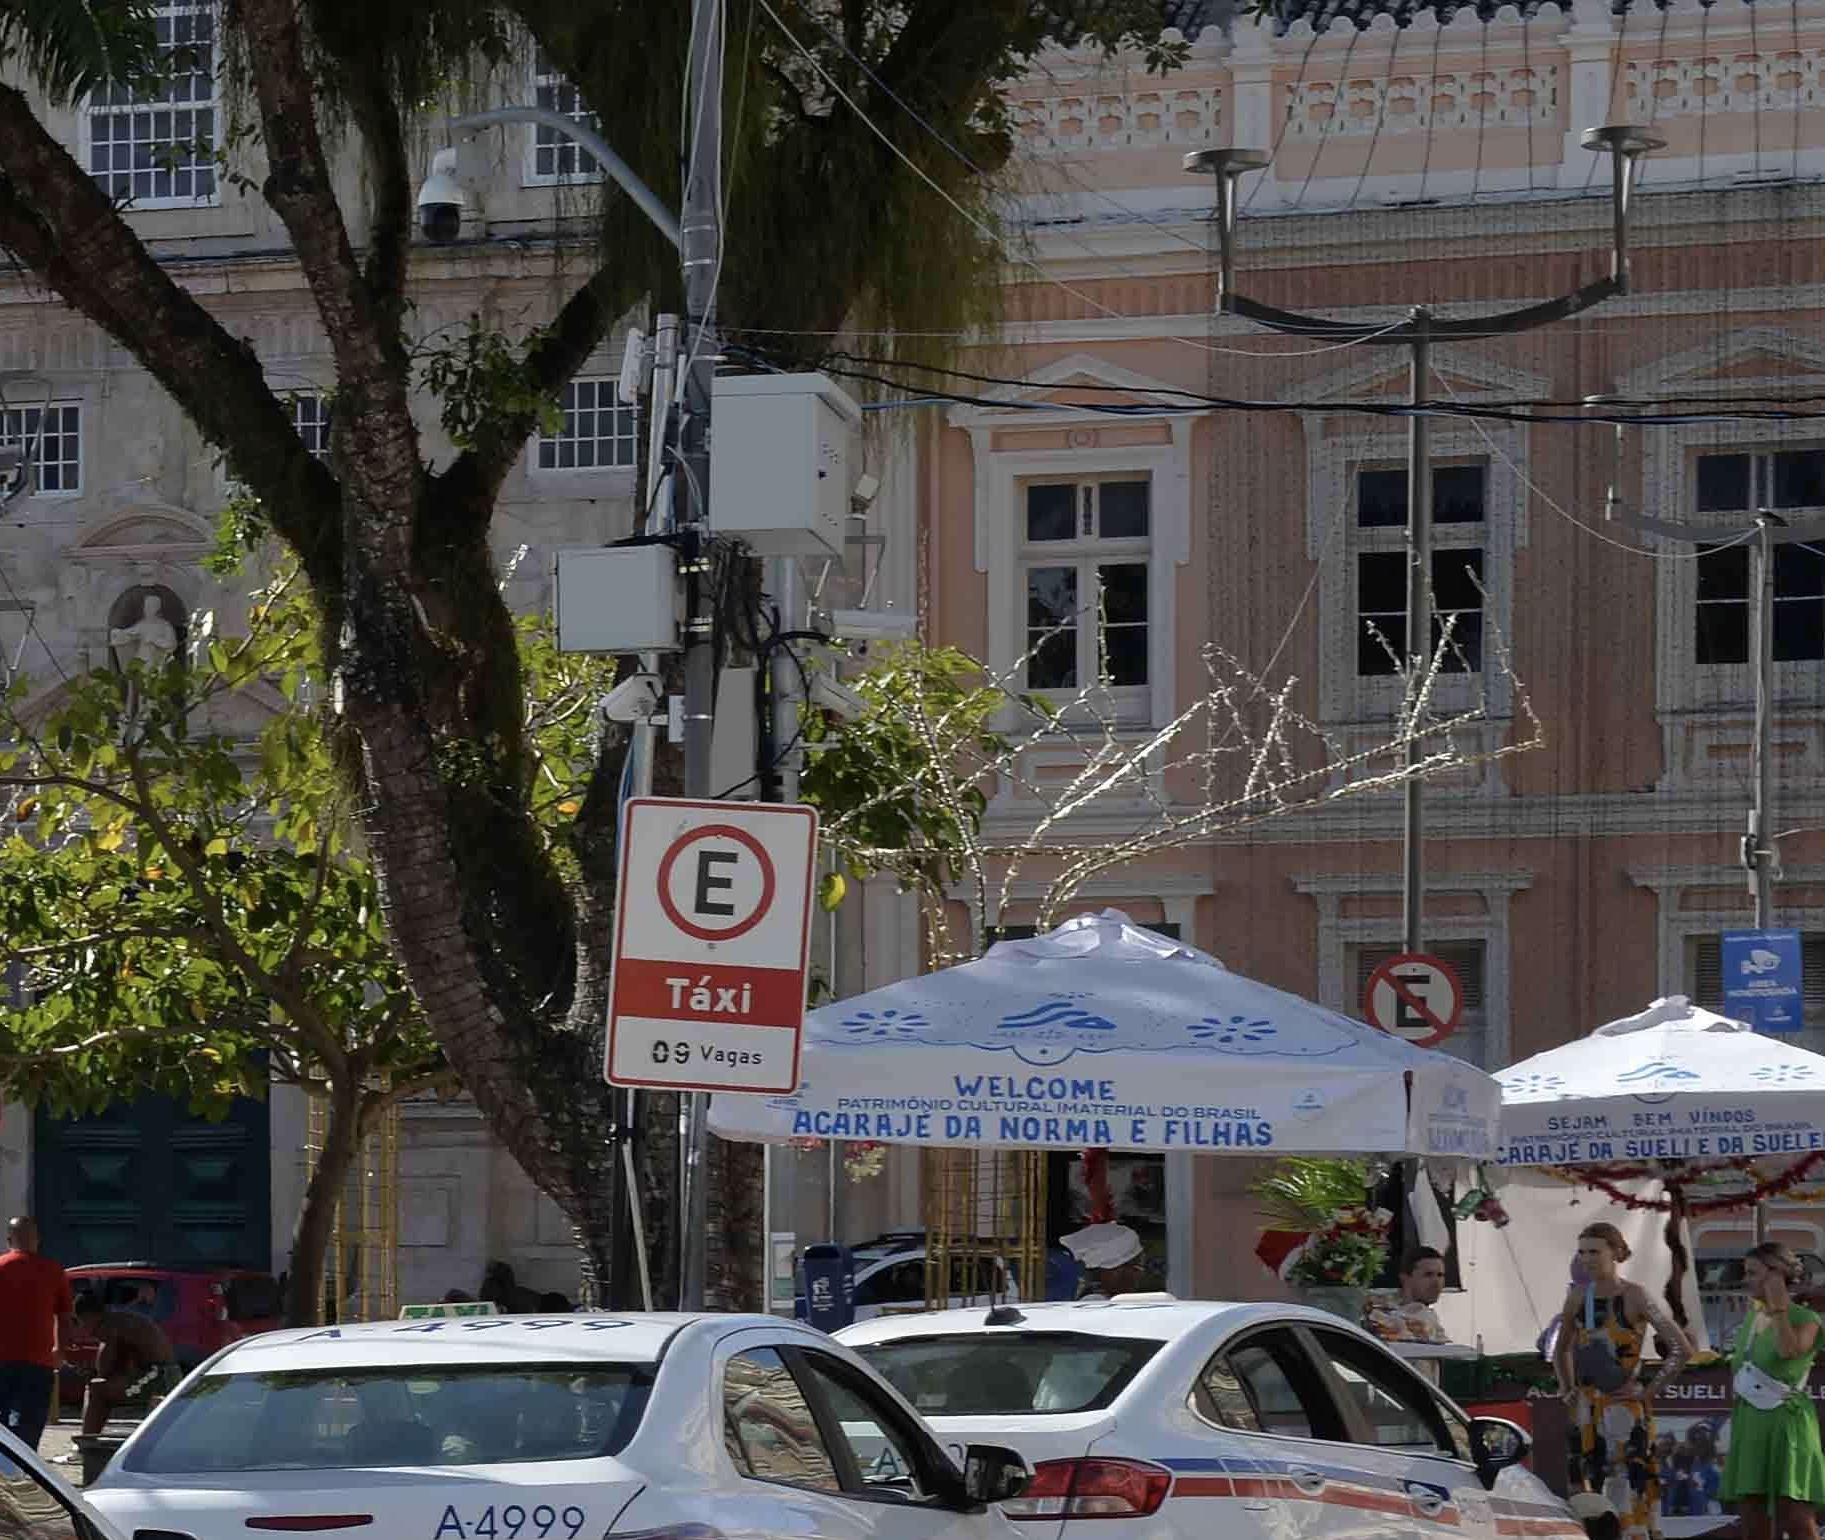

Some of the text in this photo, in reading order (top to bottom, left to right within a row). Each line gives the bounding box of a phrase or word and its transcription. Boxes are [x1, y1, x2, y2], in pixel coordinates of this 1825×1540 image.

[694, 850, 739, 916] E
[665, 975, 752, 1014] Táxi
[652, 1039, 763, 1068] 09 Vagas
[953, 1074, 1116, 1102] WELCOME
[836, 1095, 1262, 1120] PATRIMÔNIO CULTURAL IMATERIAL DO BRASIL
[1548, 1114, 1608, 1131] SEJAM
[1632, 1111, 1672, 1127] BEM
[792, 1109, 1274, 1146] ACARAJÉ DA NORMA E FILHAS
[1588, 1142, 1614, 1160] DA
[1626, 1137, 1690, 1158] SUELI
[1698, 1136, 1710, 1155] E
[1717, 1135, 1744, 1155] DA
[293, 1320, 637, 1342] A-4999
[1665, 1384, 1726, 1400] SUELI
[433, 1504, 586, 1540] A-4999
